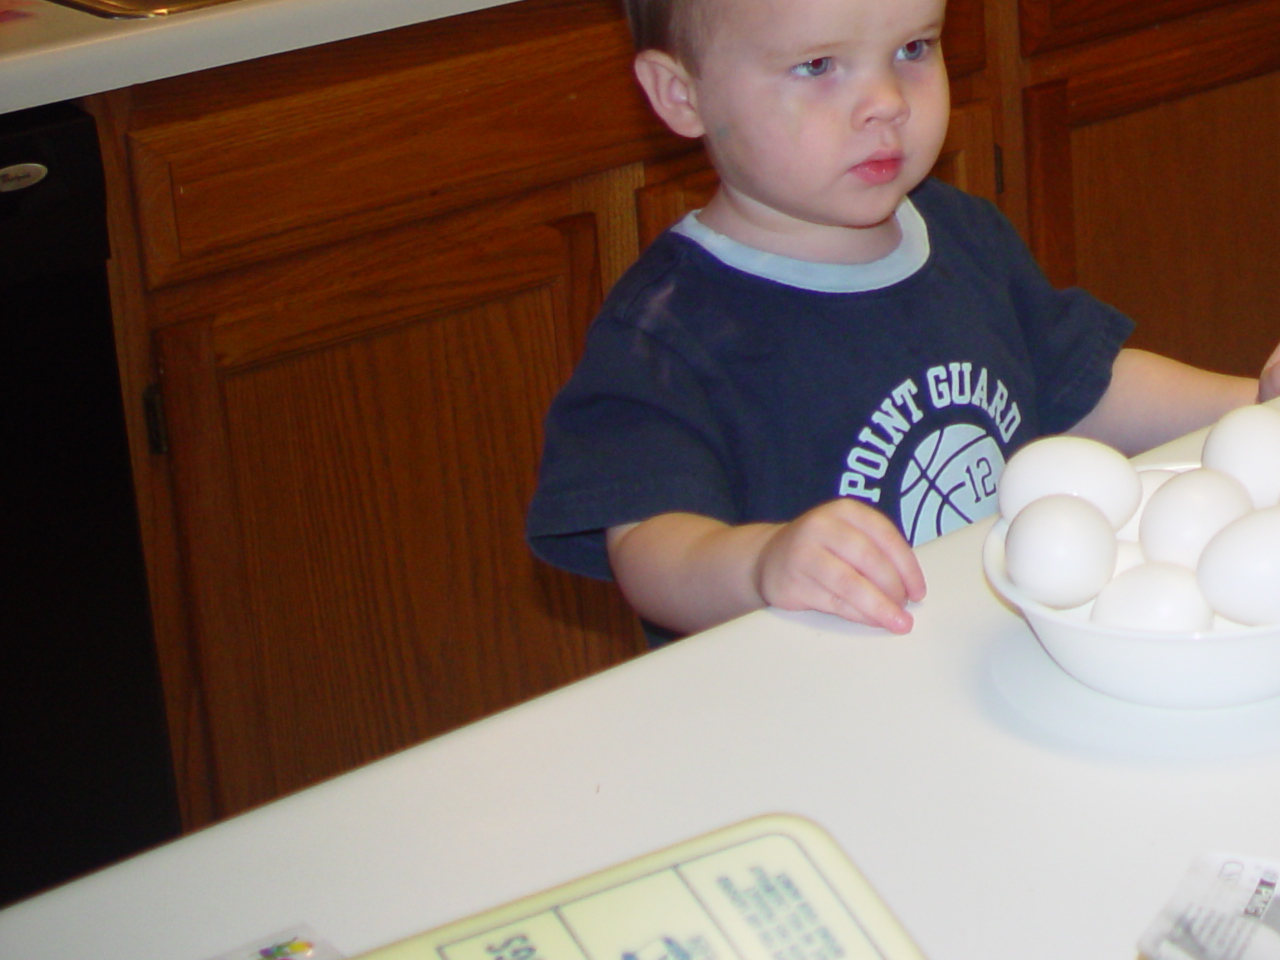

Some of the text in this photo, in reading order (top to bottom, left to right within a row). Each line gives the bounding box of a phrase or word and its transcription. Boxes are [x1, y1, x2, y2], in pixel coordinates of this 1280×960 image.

[839, 362, 1021, 503] POINT GUARD
[965, 457, 997, 503] 12
